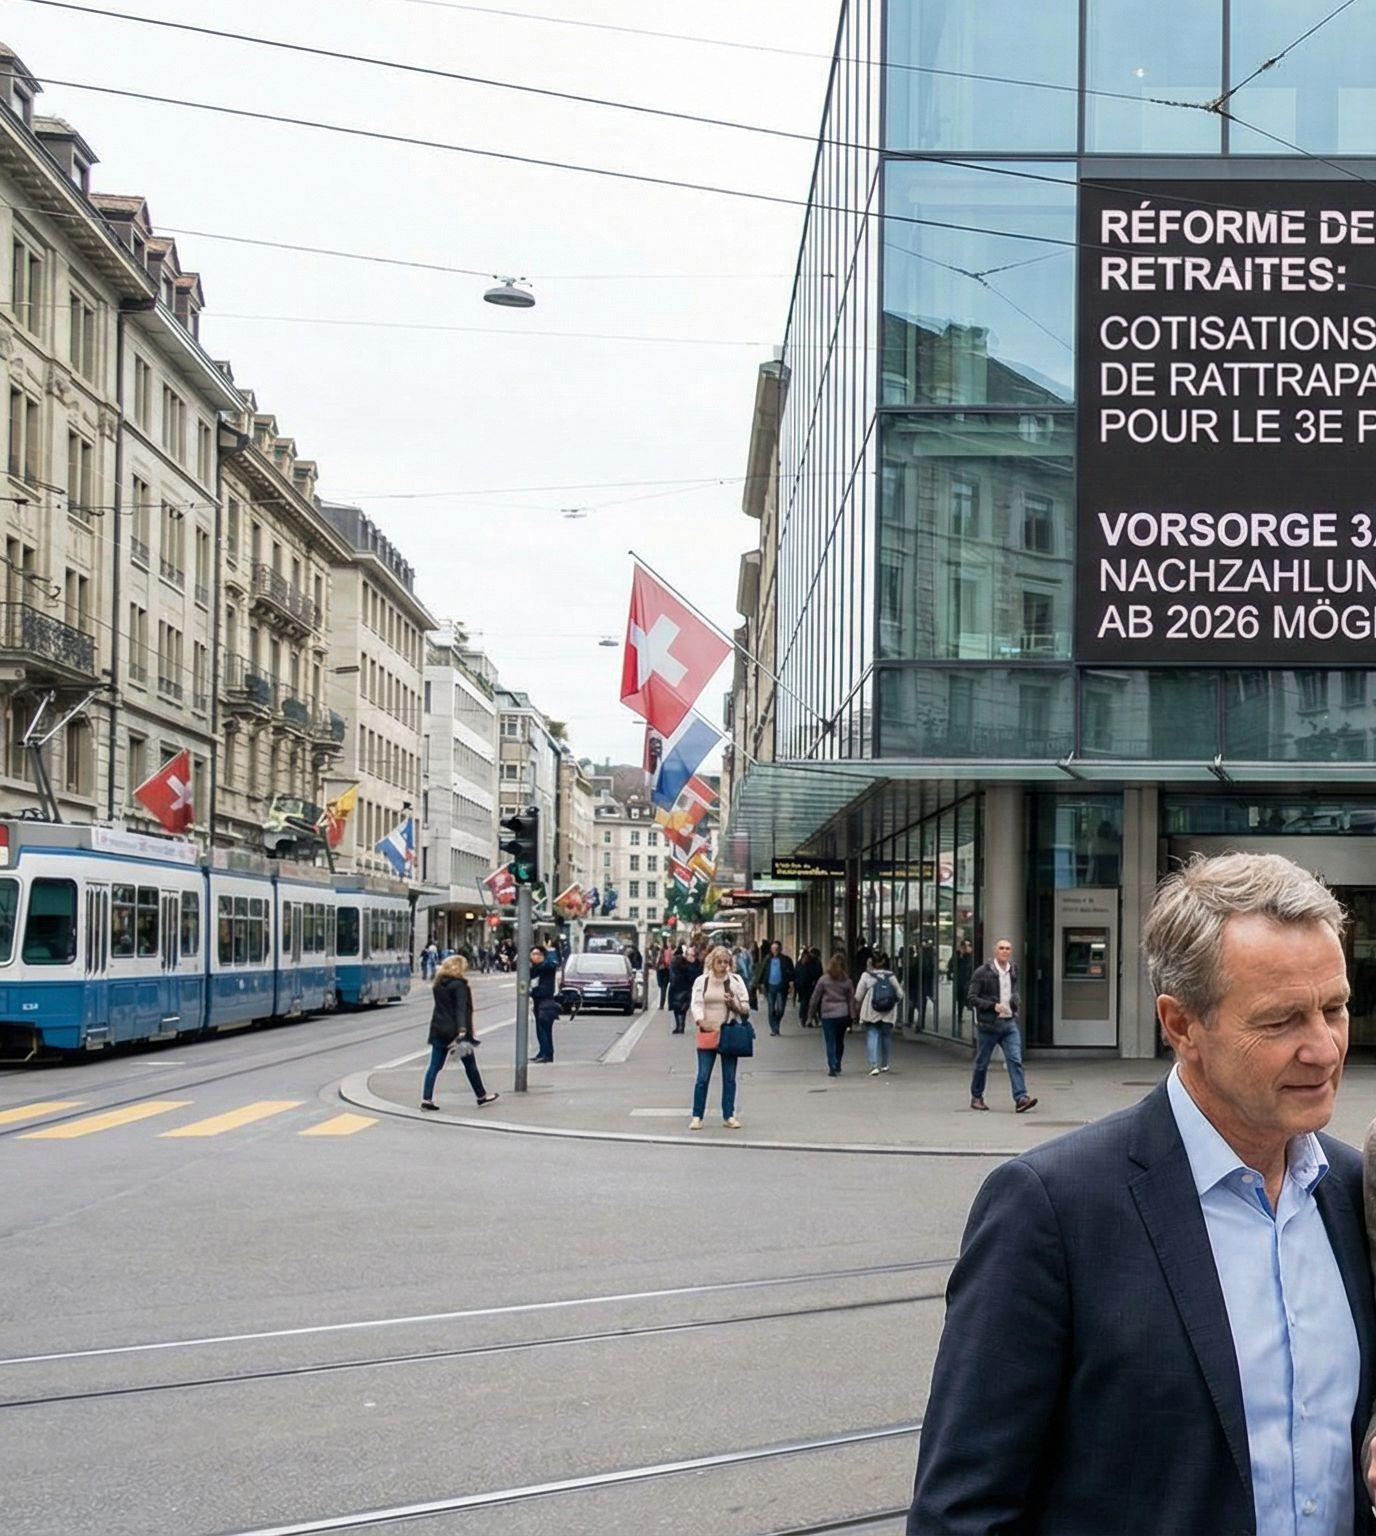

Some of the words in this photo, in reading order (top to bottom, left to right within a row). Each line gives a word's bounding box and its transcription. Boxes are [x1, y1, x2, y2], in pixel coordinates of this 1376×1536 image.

[1101, 201, 1306, 244] RÉFORME
[1101, 257, 1346, 291] RETRAITES:
[1101, 363, 1155, 396] DE
[1100, 409, 1219, 443] POUR
[1233, 410, 1281, 443] LE
[1295, 410, 1344, 443] 3E
[1098, 513, 1337, 547] VORSORGE
[1098, 605, 1154, 639] AB
[1166, 605, 1260, 639] 2026
